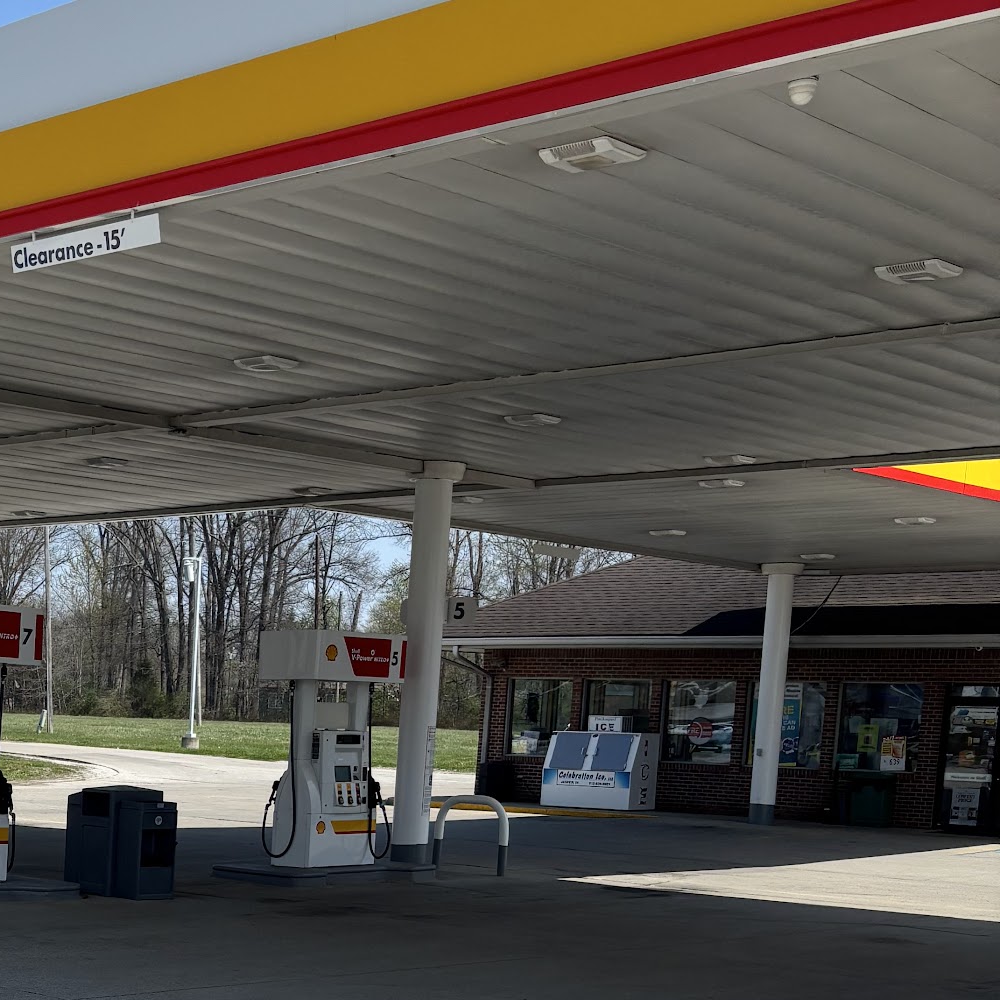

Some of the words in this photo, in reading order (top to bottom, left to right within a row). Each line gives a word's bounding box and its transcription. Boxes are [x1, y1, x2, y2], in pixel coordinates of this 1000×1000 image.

[13, 241, 94, 269] Clearance
[453, 602, 465, 620] 5
[22, 628, 33, 645] 7
[351, 653, 374, 662] V-Power
[391, 651, 399, 666] 5
[596, 723, 615, 731] ICE
[558, 771, 594, 780] Celebration
